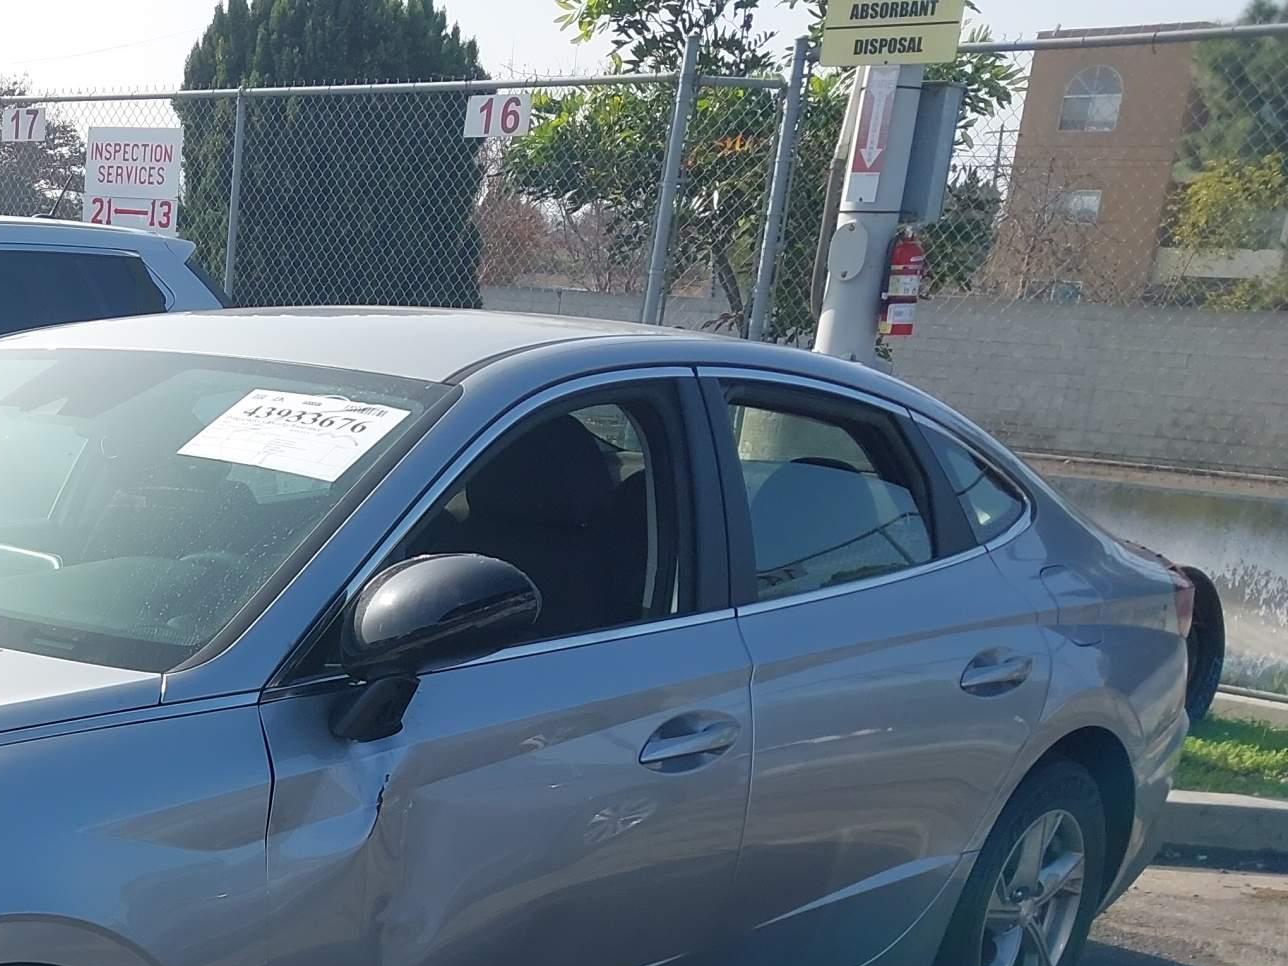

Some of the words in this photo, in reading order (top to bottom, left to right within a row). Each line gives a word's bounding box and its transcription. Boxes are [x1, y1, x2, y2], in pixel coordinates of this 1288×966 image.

[849, 0, 939, 20] ABSORBANT
[853, 36, 924, 55] DISPOSAL
[10, 109, 39, 139] 17
[479, 96, 522, 135] 16
[90, 142, 174, 163] INSPECTION
[97, 165, 165, 185] SERVICES
[242, 405, 375, 434] 43933676
